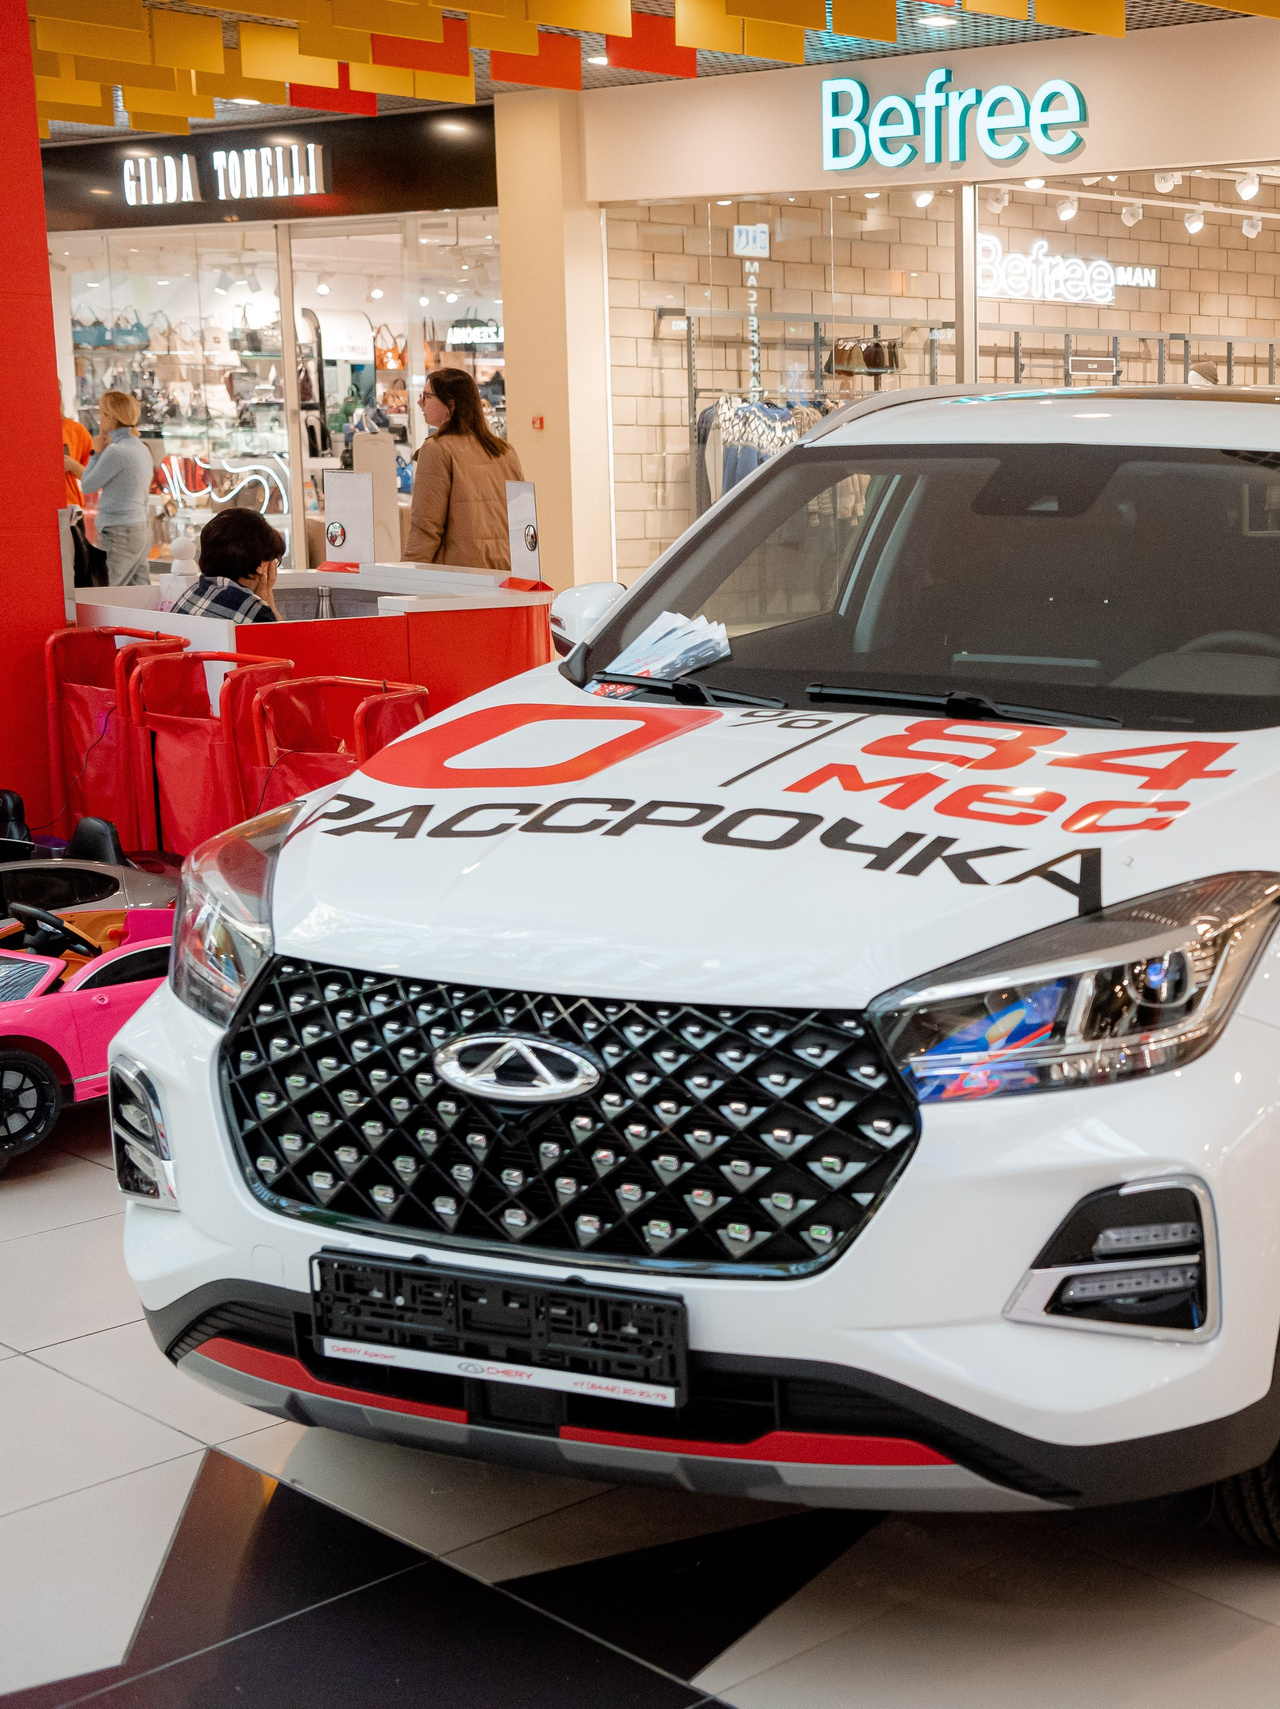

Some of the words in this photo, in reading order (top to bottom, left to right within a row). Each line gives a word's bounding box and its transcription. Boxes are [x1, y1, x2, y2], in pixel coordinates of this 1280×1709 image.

[821, 67, 1089, 171] Befree
[123, 152, 200, 206] GILDA
[212, 142, 324, 200] TONELLI
[977, 235, 1115, 303] Befree
[1115, 266, 1157, 288] MAN
[860, 718, 1240, 791] 84
[288, 790, 1103, 918] РАССРОЧКА
[486, 1366, 533, 1380] CHERY
